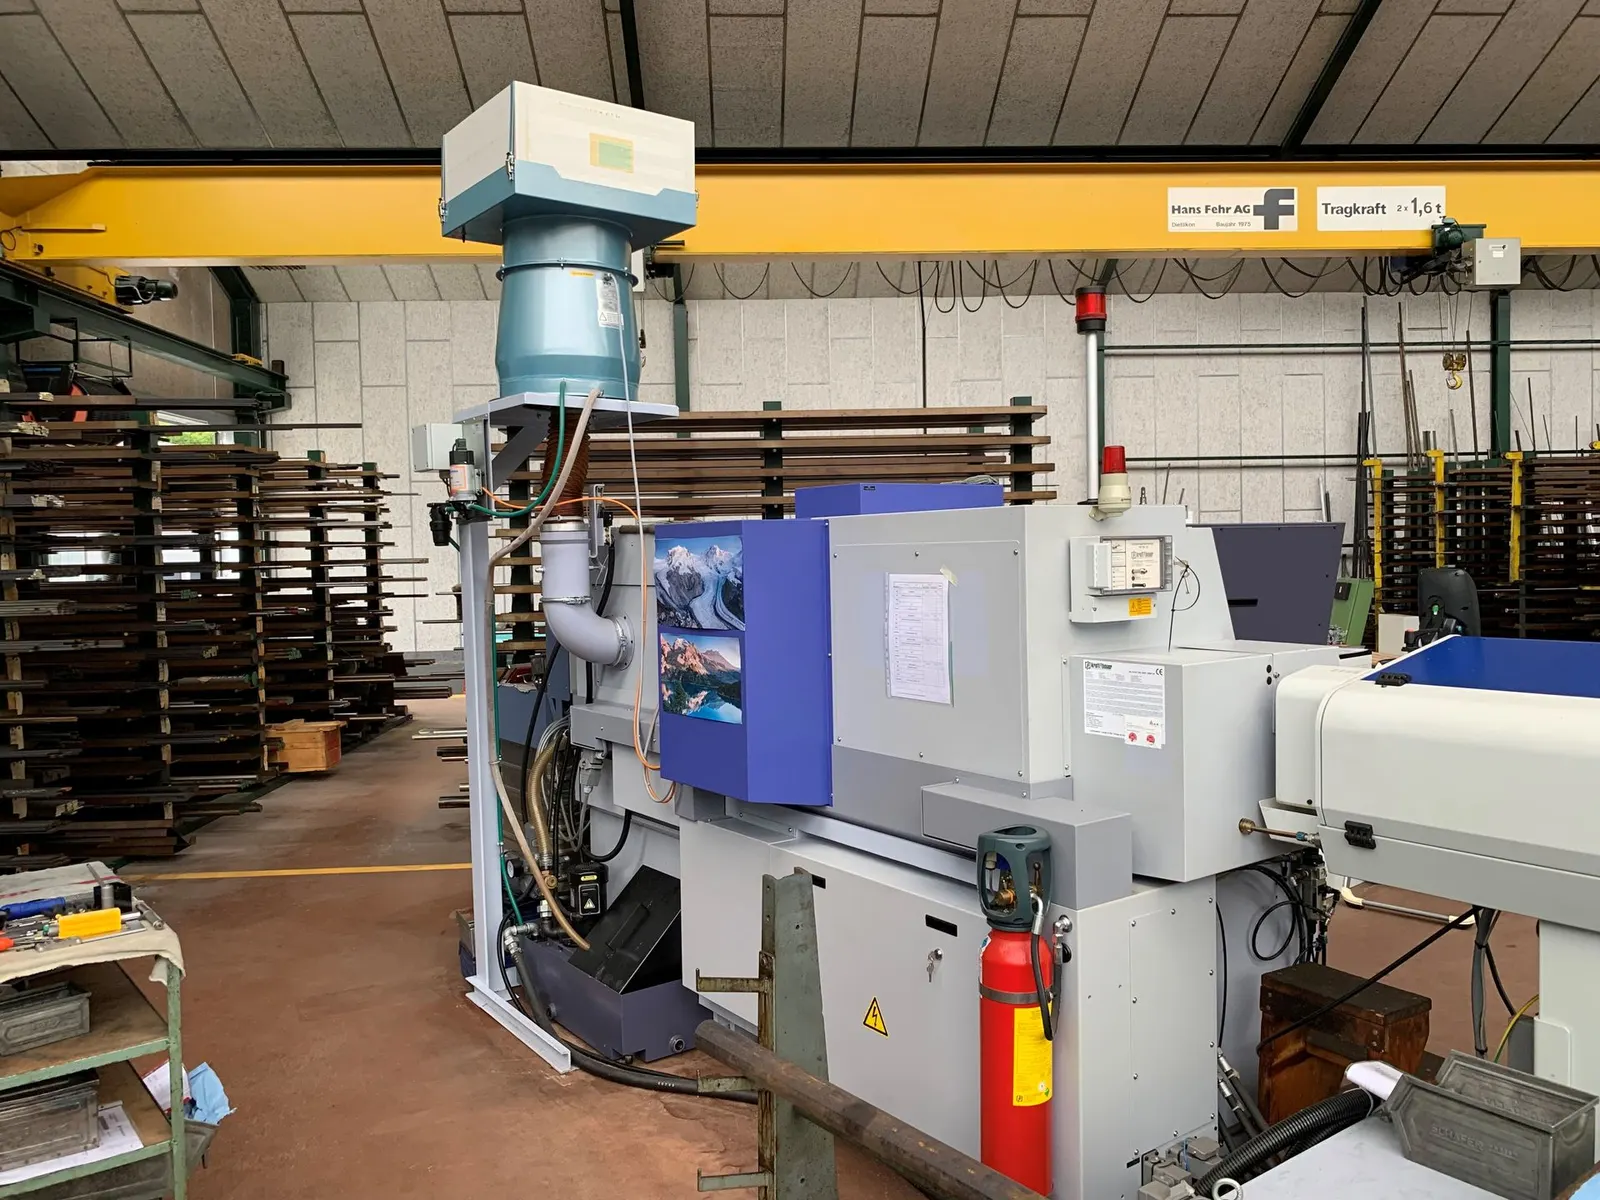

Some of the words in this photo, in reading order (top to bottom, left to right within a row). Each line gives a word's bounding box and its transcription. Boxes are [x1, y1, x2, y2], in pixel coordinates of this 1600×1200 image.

[1171, 204, 1202, 215] Hans
[1204, 204, 1232, 214] Fehr
[1233, 204, 1251, 214] AG
[1321, 202, 1387, 218] Tragkraft
[1396, 204, 1402, 212] 2
[1410, 197, 1433, 217] 1,6
[1435, 203, 1442, 214] t
